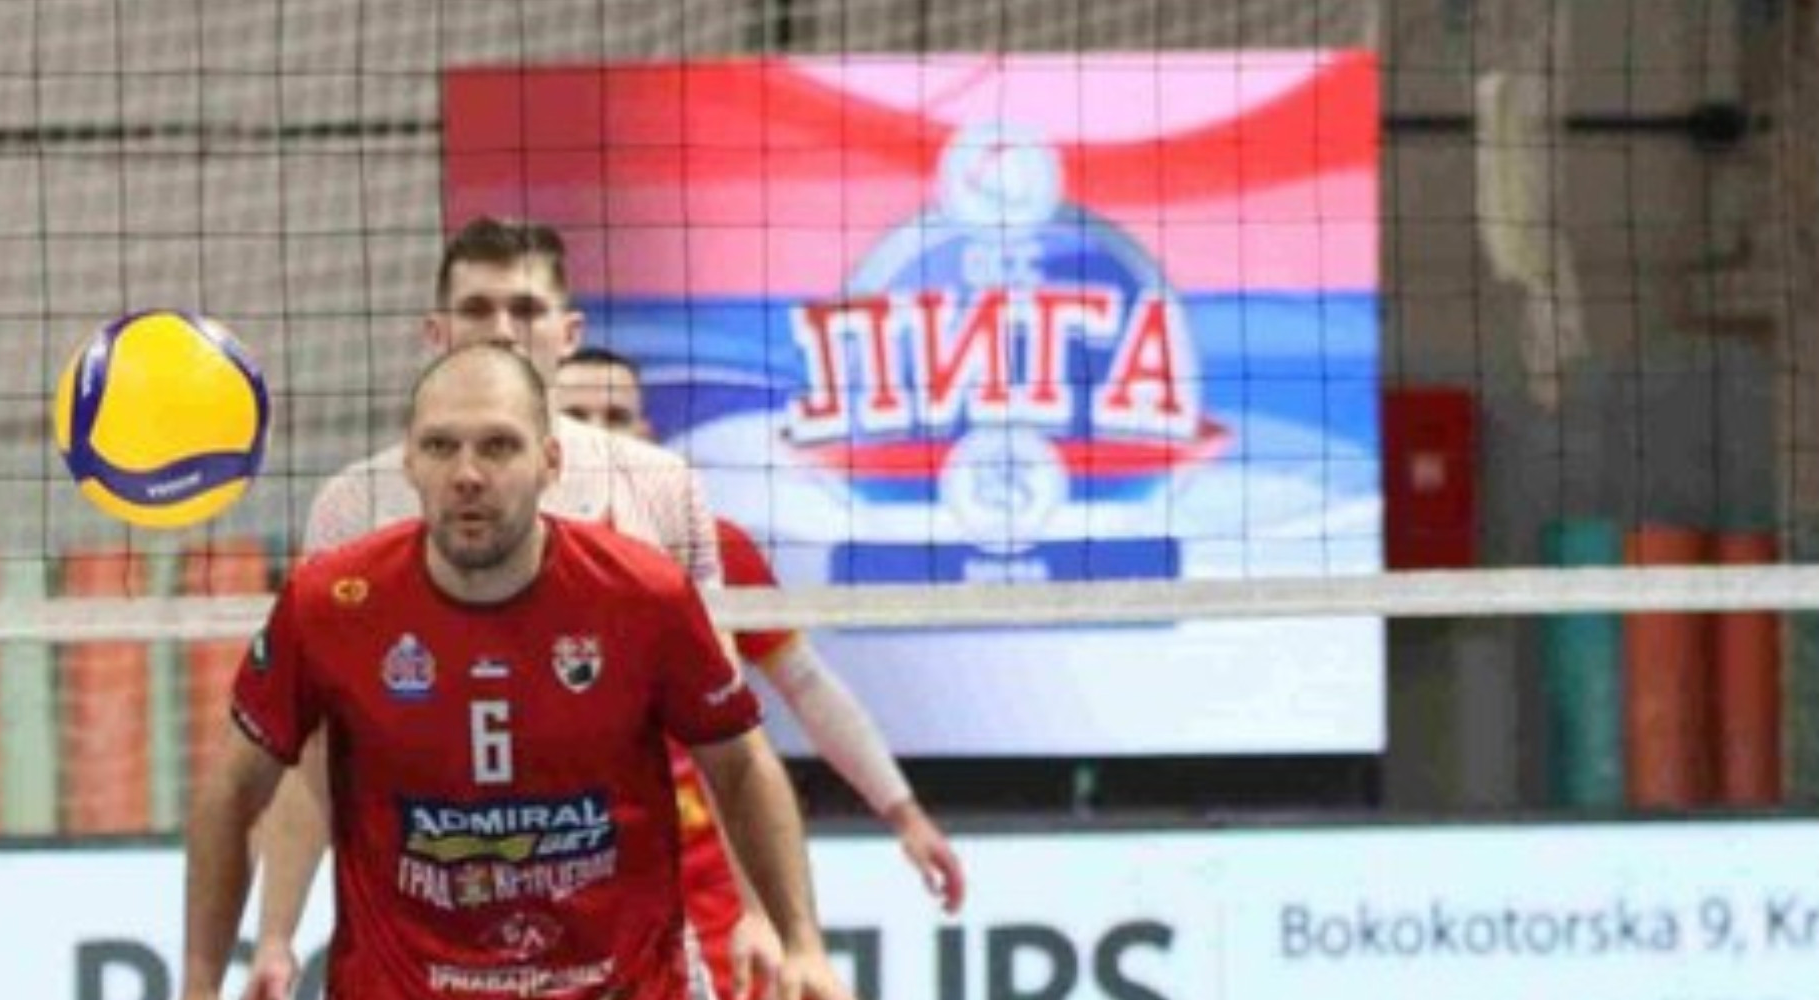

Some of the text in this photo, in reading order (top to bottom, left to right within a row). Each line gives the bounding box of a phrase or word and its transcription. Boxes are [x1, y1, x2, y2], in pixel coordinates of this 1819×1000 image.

[791, 286, 1191, 430] ЛИГА
[470, 700, 513, 784] 6
[411, 797, 611, 835] ADMIRAL
[1280, 899, 1678, 959] Bokokotorska
[1699, 898, 1748, 955] 9,
